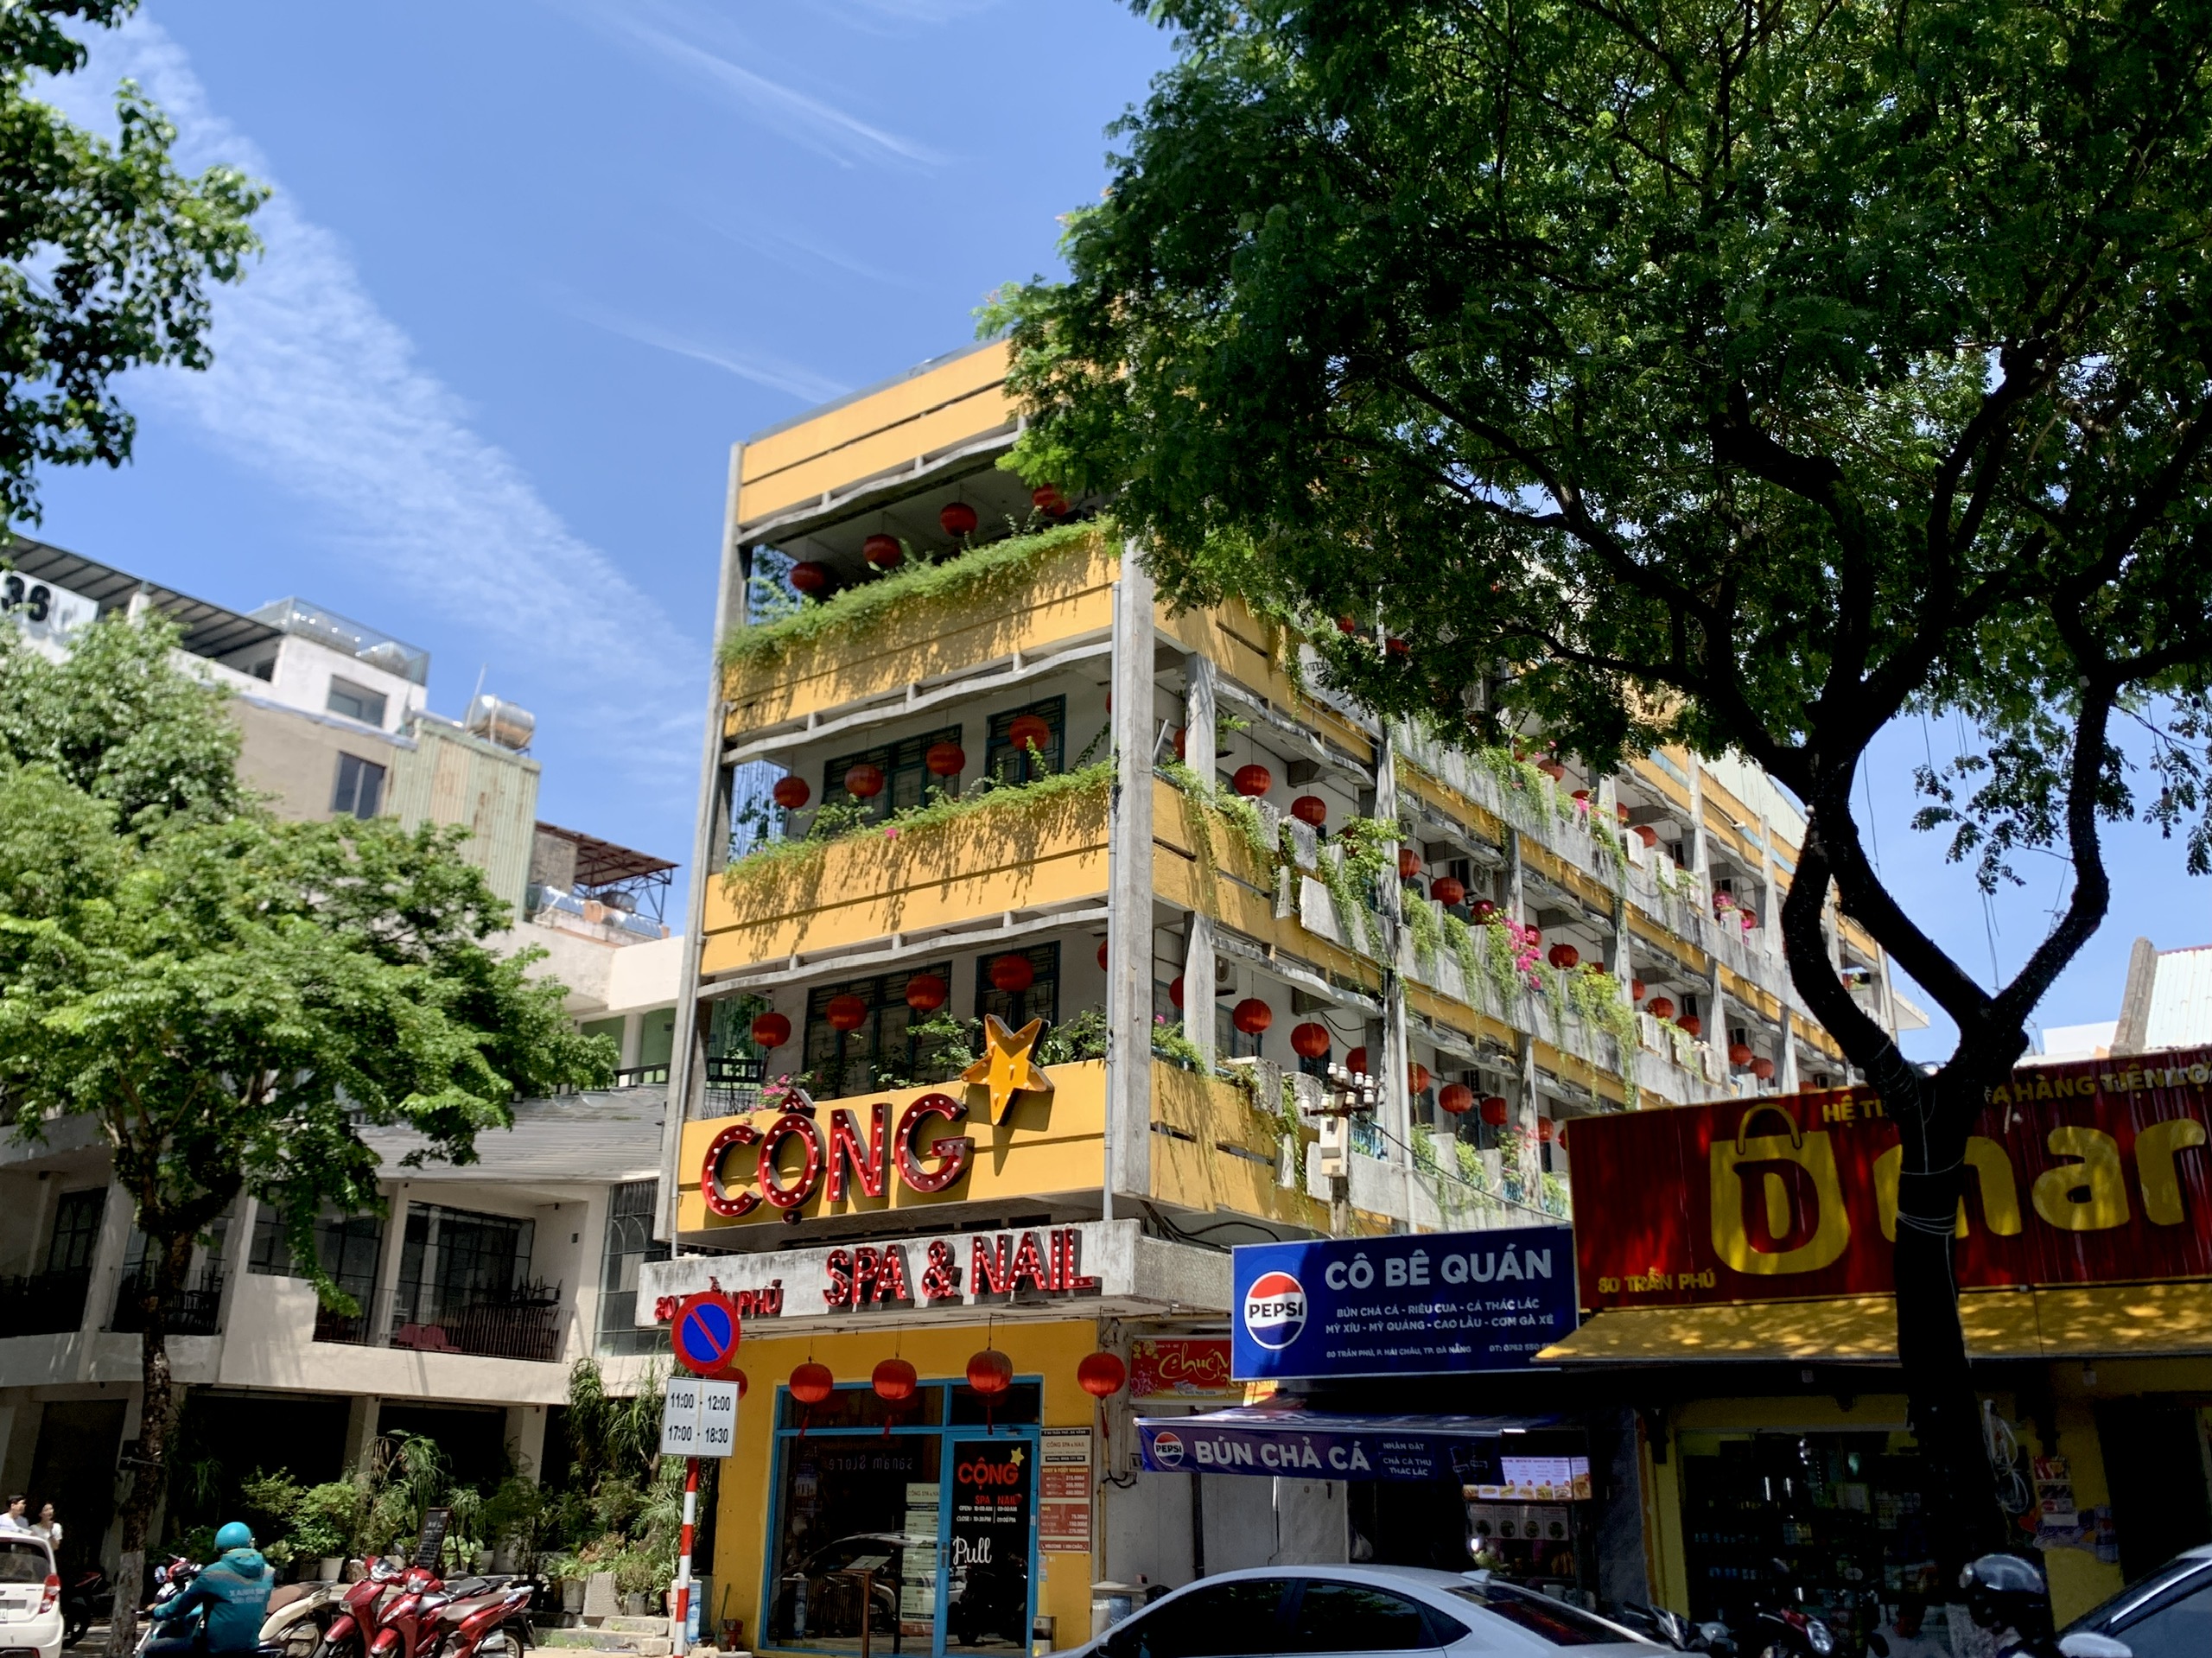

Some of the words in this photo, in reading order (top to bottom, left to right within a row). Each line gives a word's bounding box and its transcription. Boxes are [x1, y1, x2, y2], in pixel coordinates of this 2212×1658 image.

[1822, 1098, 1855, 1128] HỆ
[2016, 1074, 2096, 1102] HÀNG
[2100, 1063, 2166, 1100] TIỆN
[701, 1087, 974, 1225] CỘNG
[823, 1243, 912, 1308] SPA
[921, 1240, 962, 1304] &
[971, 1228, 1102, 1294] NAIL
[1325, 1252, 1375, 1291] CÔ
[1384, 1248, 1431, 1287] BÊ
[1440, 1242, 1553, 1285] QUÁN
[1599, 1276, 1621, 1293] 80
[1624, 1266, 1673, 1293] TRẦN
[1678, 1267, 1716, 1290] PHÚ
[654, 1295, 678, 1321] 80
[739, 1279, 785, 1316] PHÚ
[1249, 1301, 1304, 1319] PEPSI
[1337, 1306, 1358, 1318] BÚN
[1434, 1303, 1458, 1314] CUA
[1433, 1319, 1458, 1330] CAO
[1519, 1314, 1536, 1325] GÀ
[671, 1392, 694, 1408] 11:00
[708, 1394, 731, 1412] 12:00
[668, 1425, 692, 1442] 17:00
[705, 1427, 728, 1444] 18:30
[1155, 1444, 1183, 1454] PEPSI
[1194, 1435, 1254, 1466] BÚN
[1260, 1436, 1323, 1469] CHẢ
[1328, 1440, 1372, 1471] CÁ
[1414, 1458, 1432, 1467] THU
[957, 1457, 1019, 1490] CỘNG
[975, 1495, 991, 1505] SPA
[997, 1495, 1016, 1505] NAIL
[952, 1535, 993, 1566] Pull
